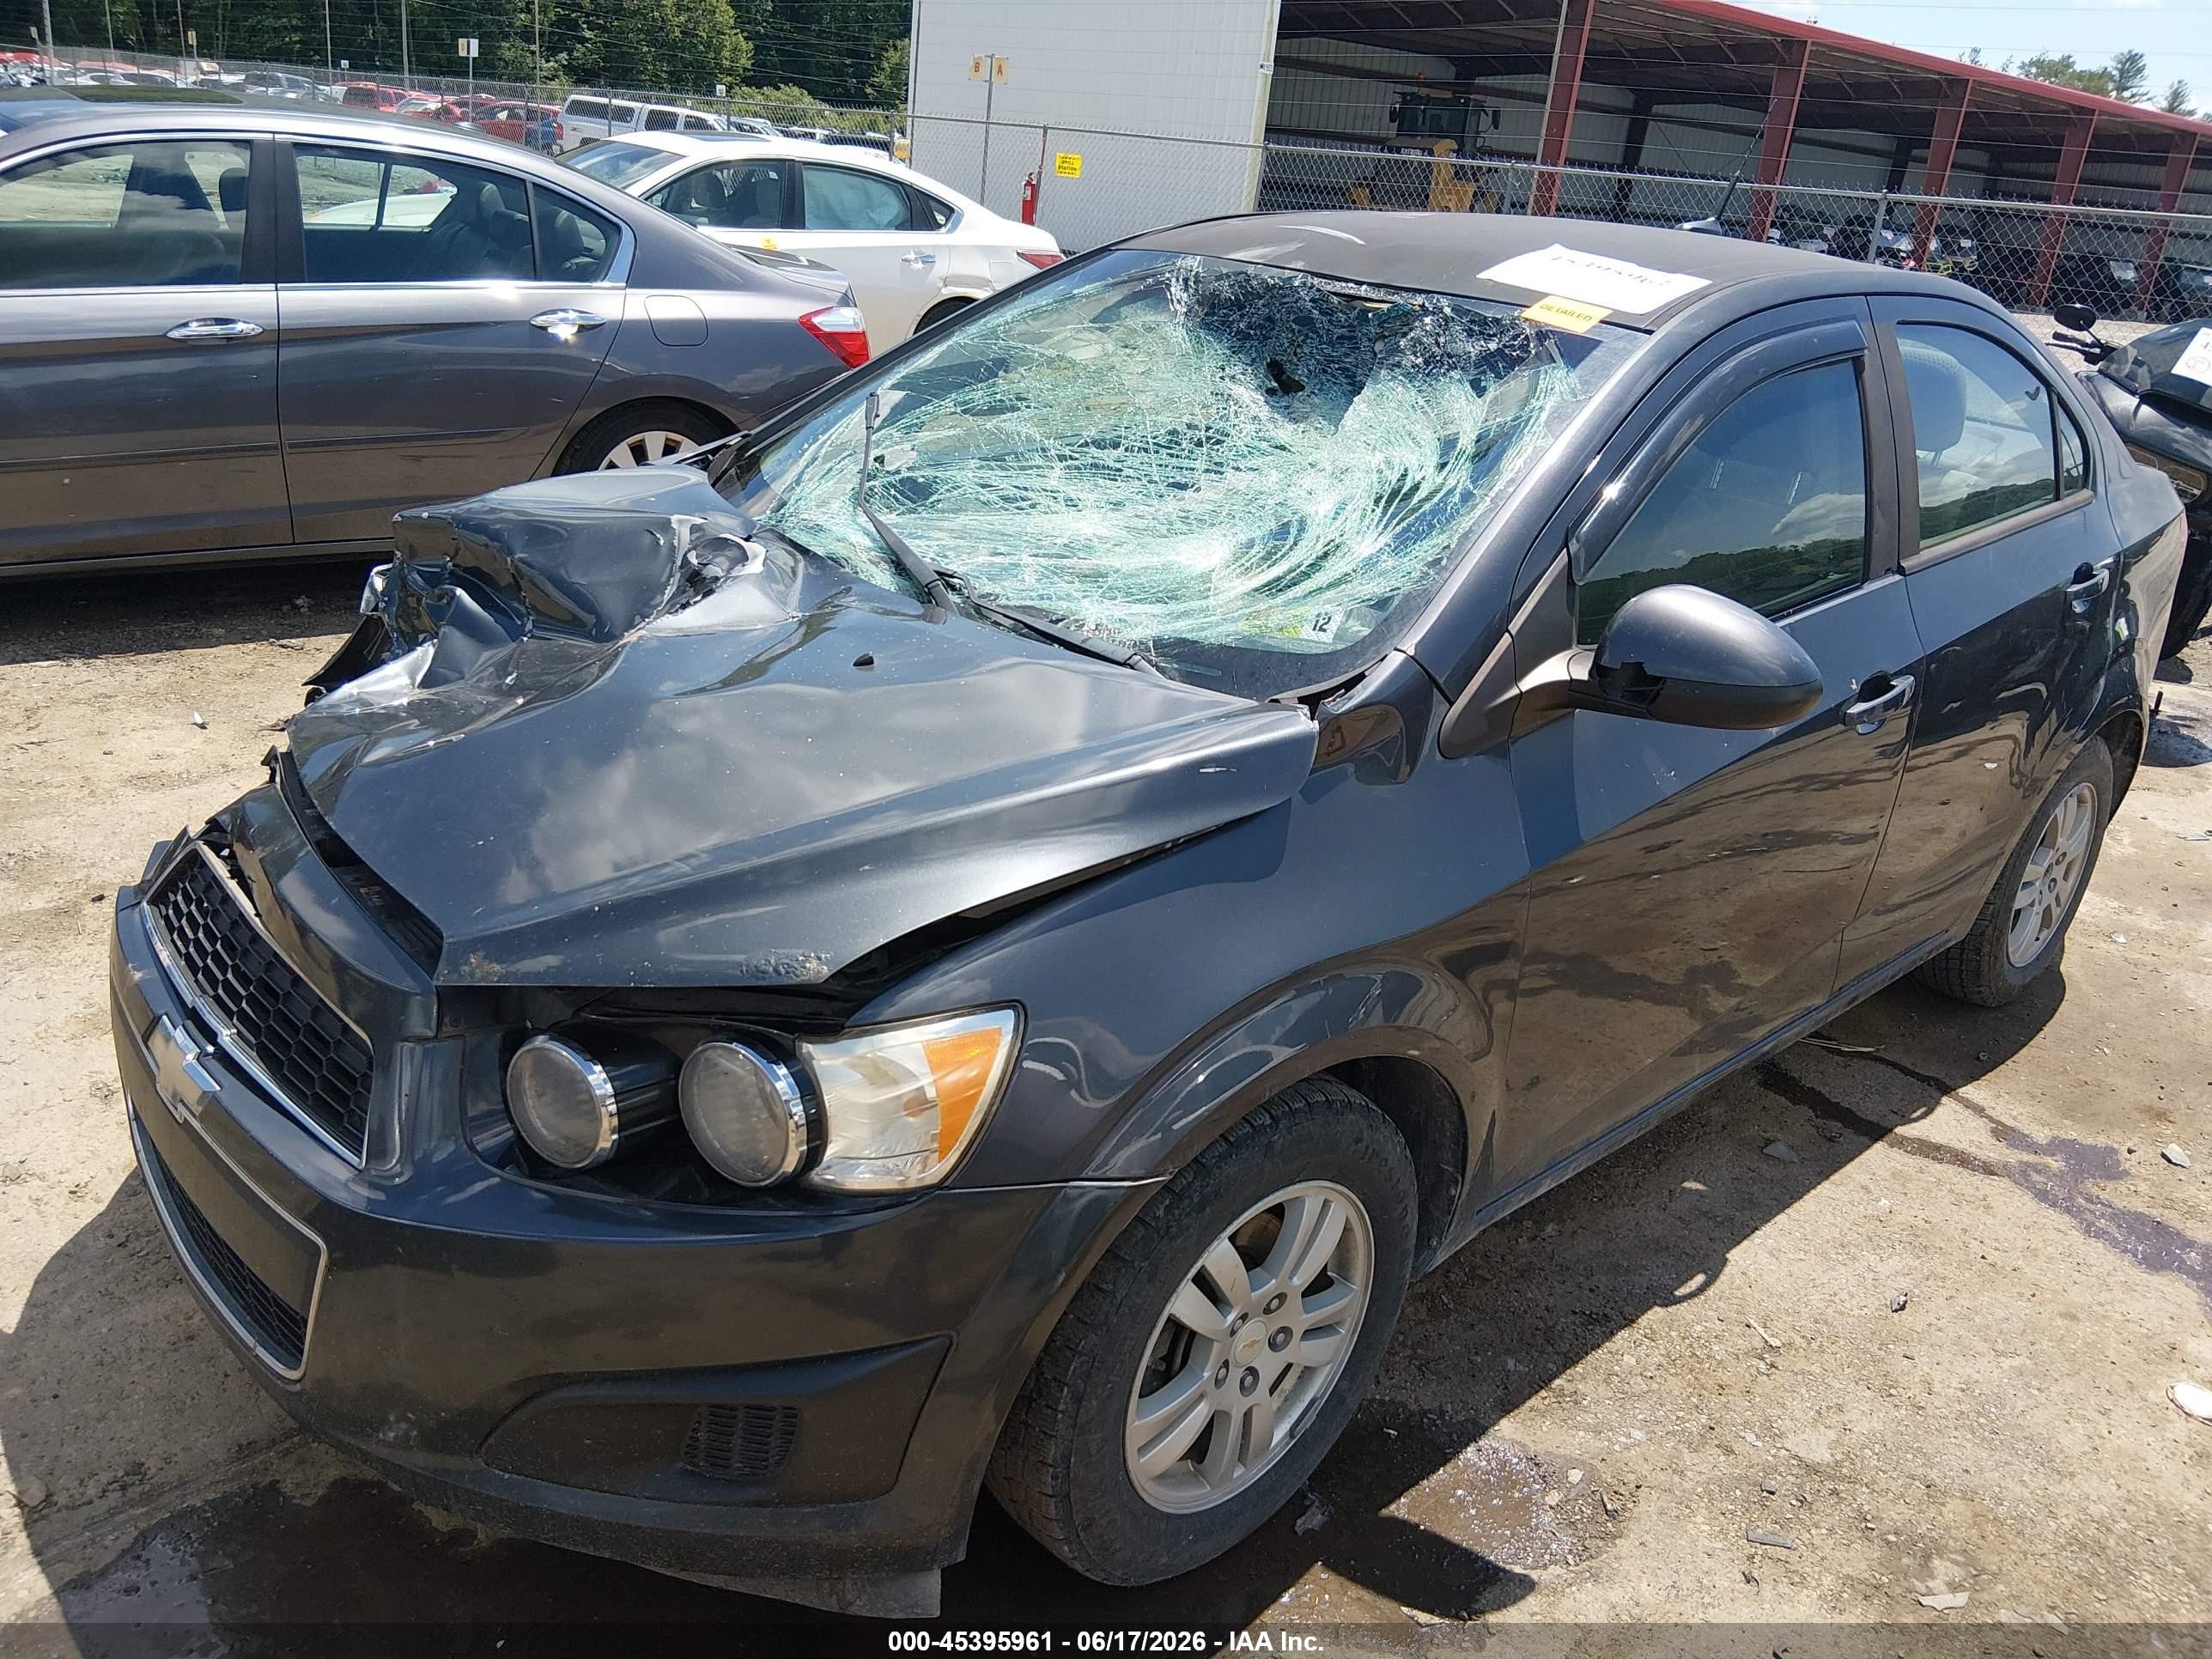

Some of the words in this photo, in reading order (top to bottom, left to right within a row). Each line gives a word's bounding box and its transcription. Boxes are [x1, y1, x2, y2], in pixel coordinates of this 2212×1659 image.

[974, 61, 981, 73] B
[997, 64, 1003, 76] A
[1540, 303, 1593, 322] DETAILED
[1311, 615, 1333, 633] 12
